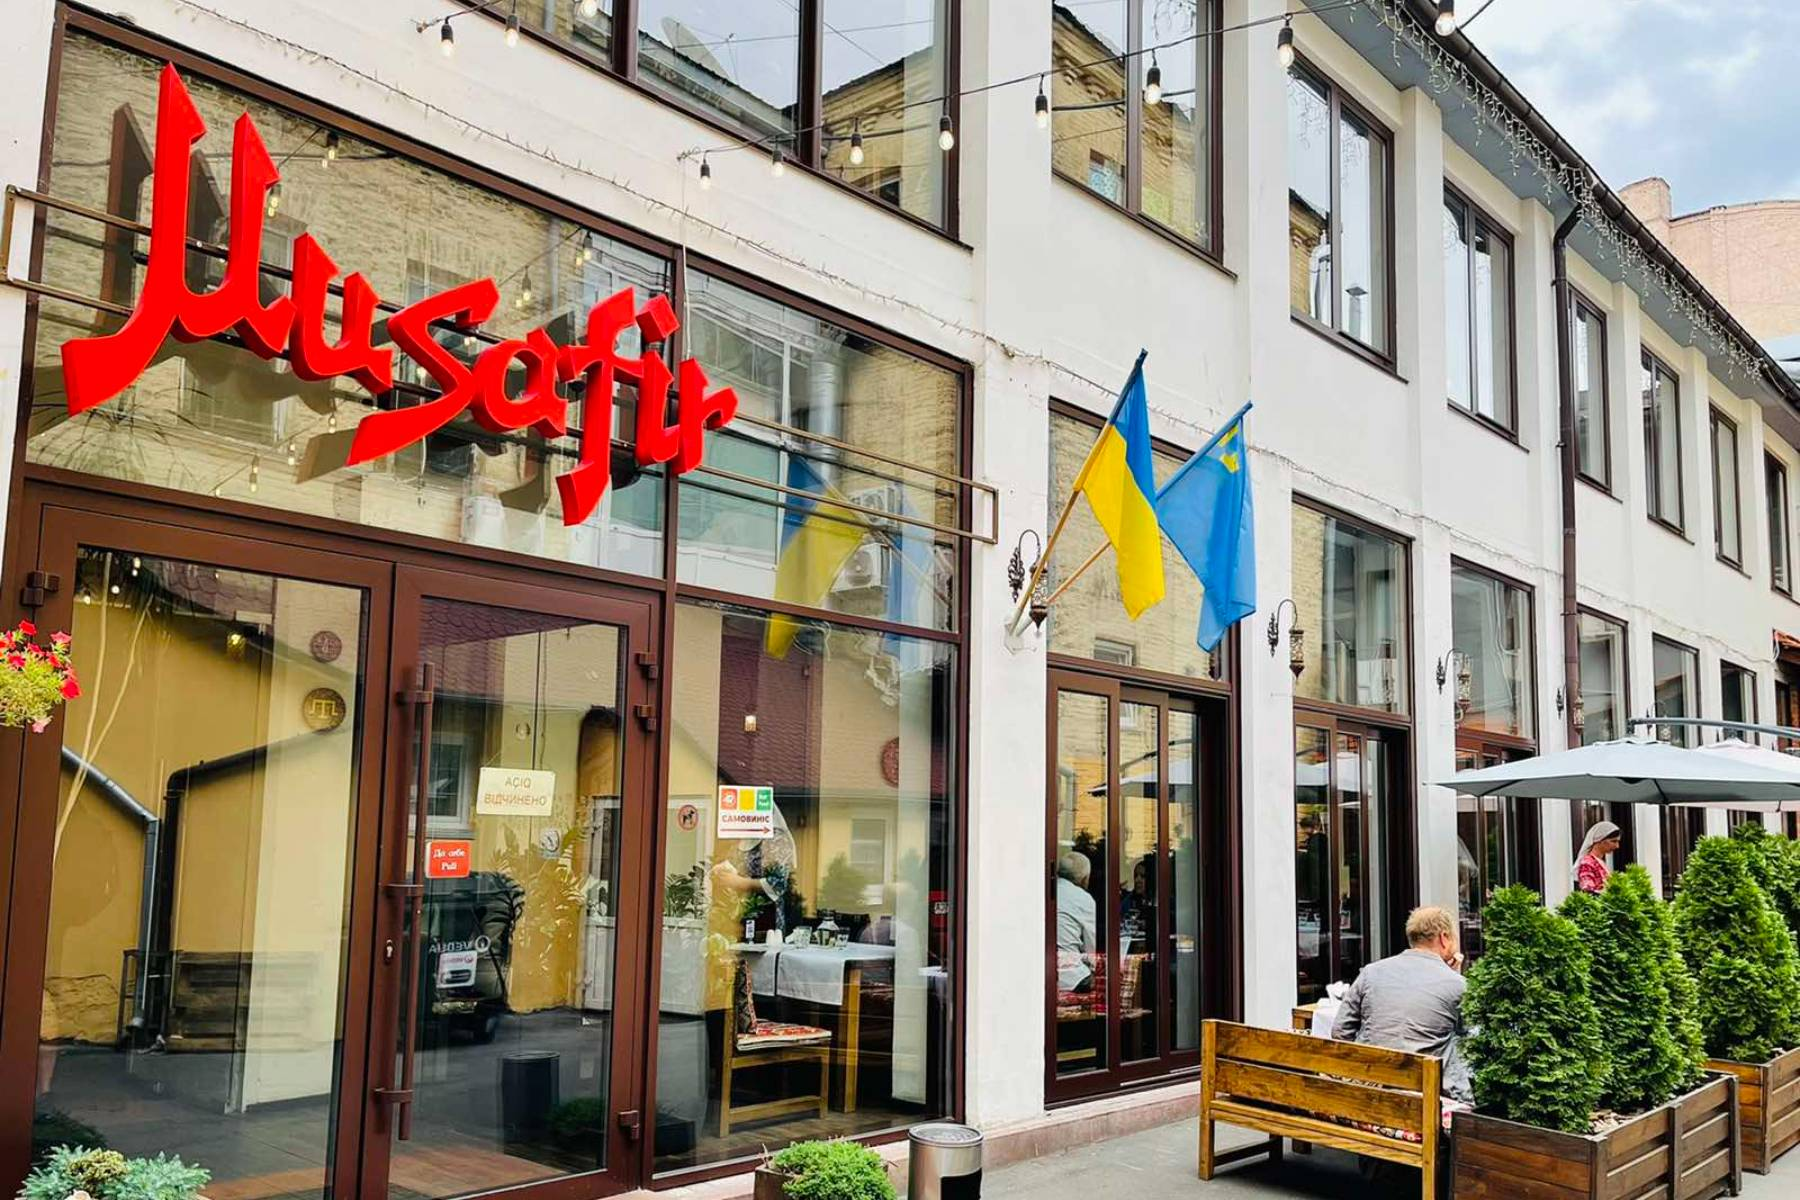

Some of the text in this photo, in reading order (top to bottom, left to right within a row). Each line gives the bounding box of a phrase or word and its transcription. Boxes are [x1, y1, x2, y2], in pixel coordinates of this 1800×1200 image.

[61, 61, 738, 526] Musafir
[484, 793, 546, 807] ВІДЧИНЕНО
[722, 815, 770, 823] САМОВИНІС
